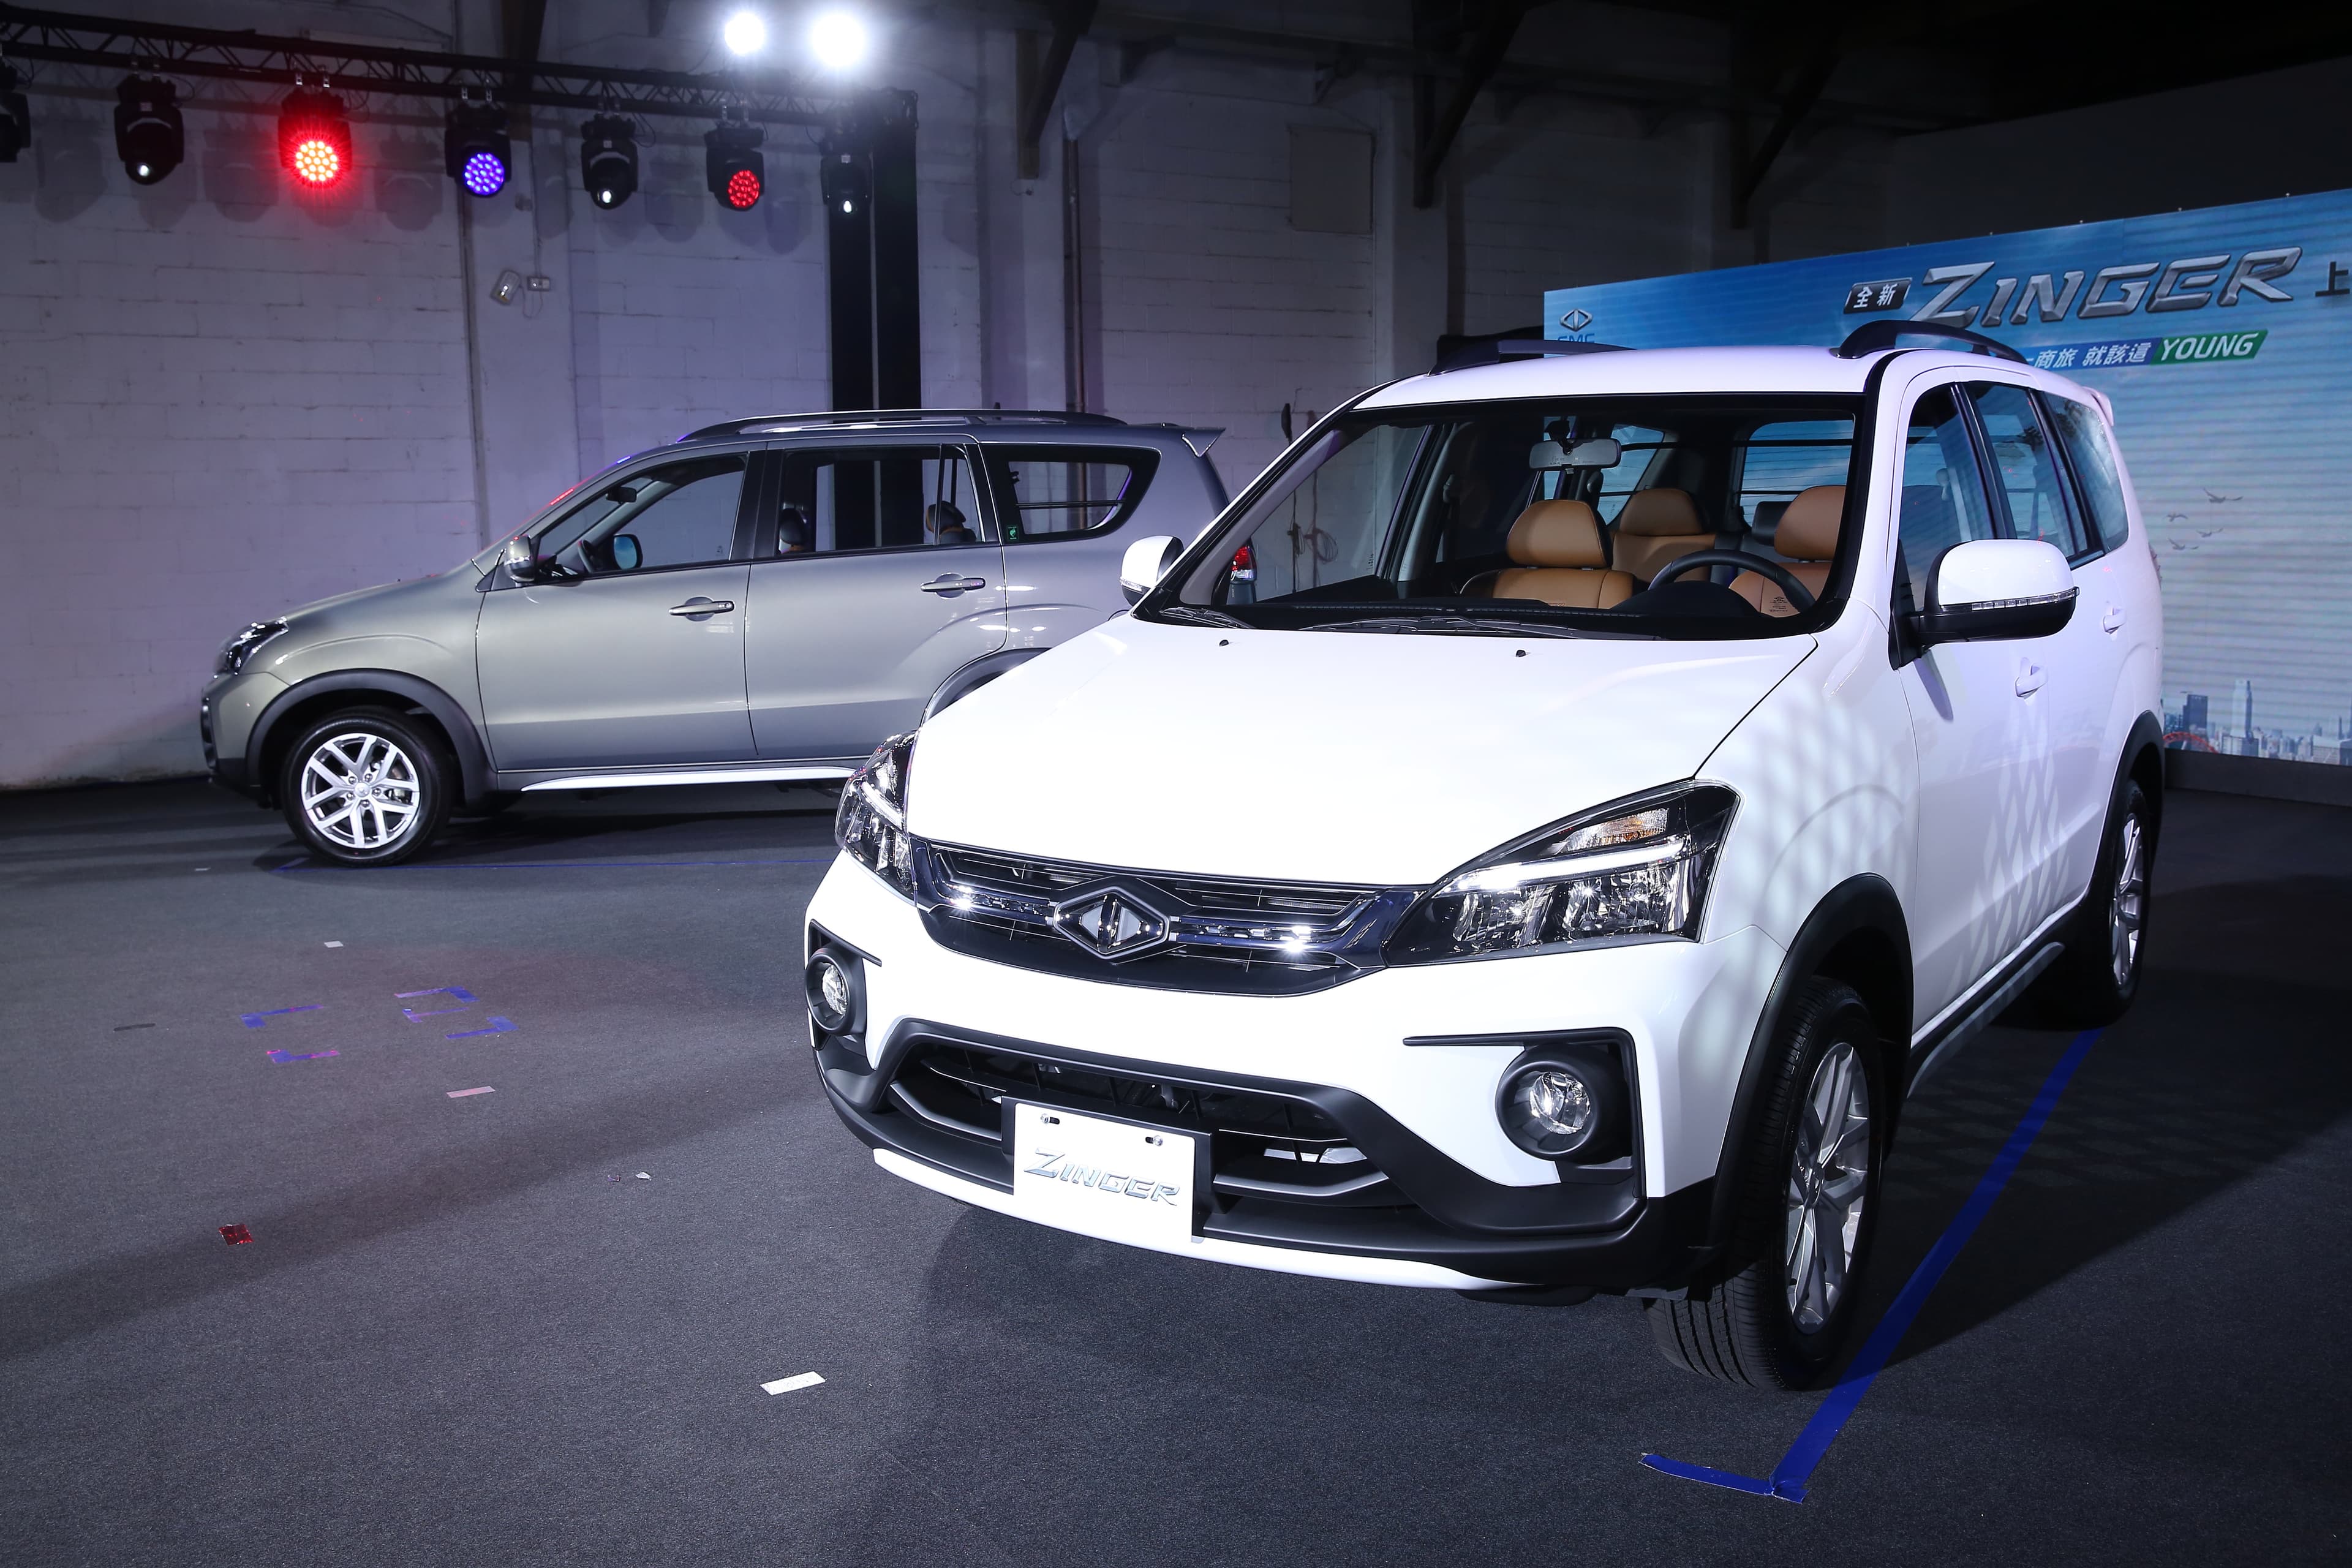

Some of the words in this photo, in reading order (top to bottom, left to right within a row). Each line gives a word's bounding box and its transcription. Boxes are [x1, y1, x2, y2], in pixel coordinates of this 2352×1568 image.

[1853, 283, 1898, 308] 全新
[1908, 246, 2303, 330] ZINGER
[2315, 261, 2351, 298] 上
[2160, 333, 2260, 361] YOUNG
[1023, 1147, 1181, 1207] ZINGER
